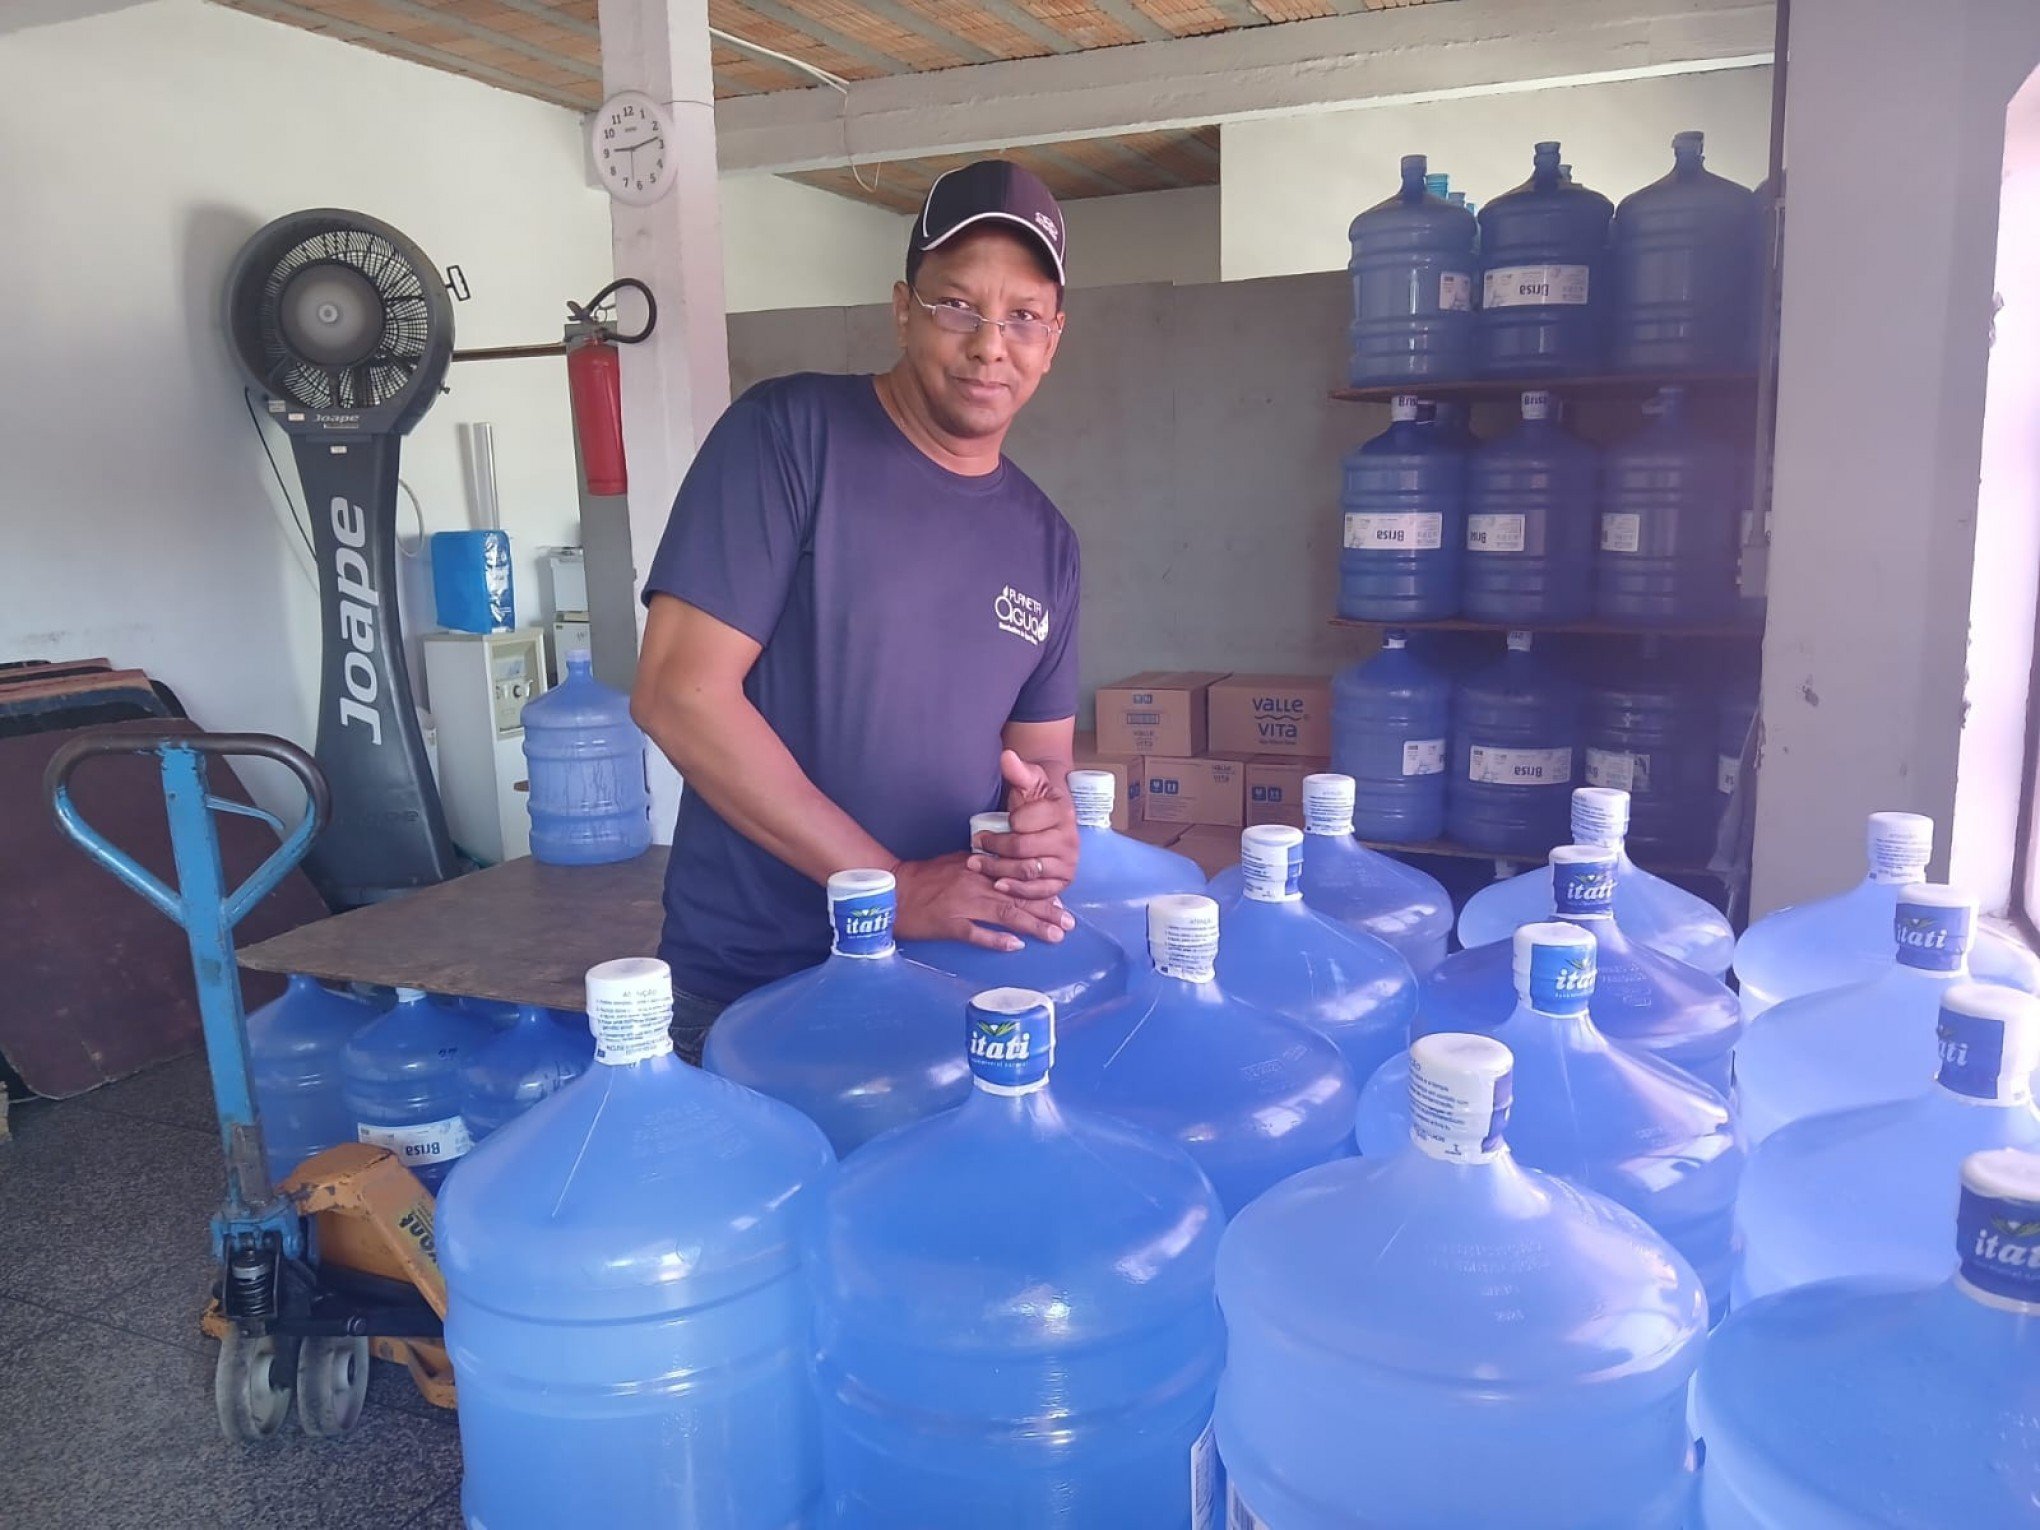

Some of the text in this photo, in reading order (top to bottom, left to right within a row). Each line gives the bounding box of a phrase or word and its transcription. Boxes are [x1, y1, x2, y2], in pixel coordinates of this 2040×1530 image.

[623, 105, 634, 117] 12
[640, 108, 645, 119] 1
[612, 114, 621, 125] 11
[652, 120, 659, 131] 2
[604, 128, 615, 139] 10
[603, 148, 610, 159] 9
[610, 166, 617, 176] 8
[623, 176, 629, 188] 7
[649, 172, 656, 183] 5
[636, 180, 643, 191] 6
[316, 413, 359, 423] Joape
[1376, 529, 1405, 542] Brisa
[329, 496, 382, 746] Joape
[1514, 765, 1543, 778] Brisa
[846, 911, 890, 934] itati
[970, 1030, 1030, 1060] itati
[405, 1142, 441, 1156] Brisa
